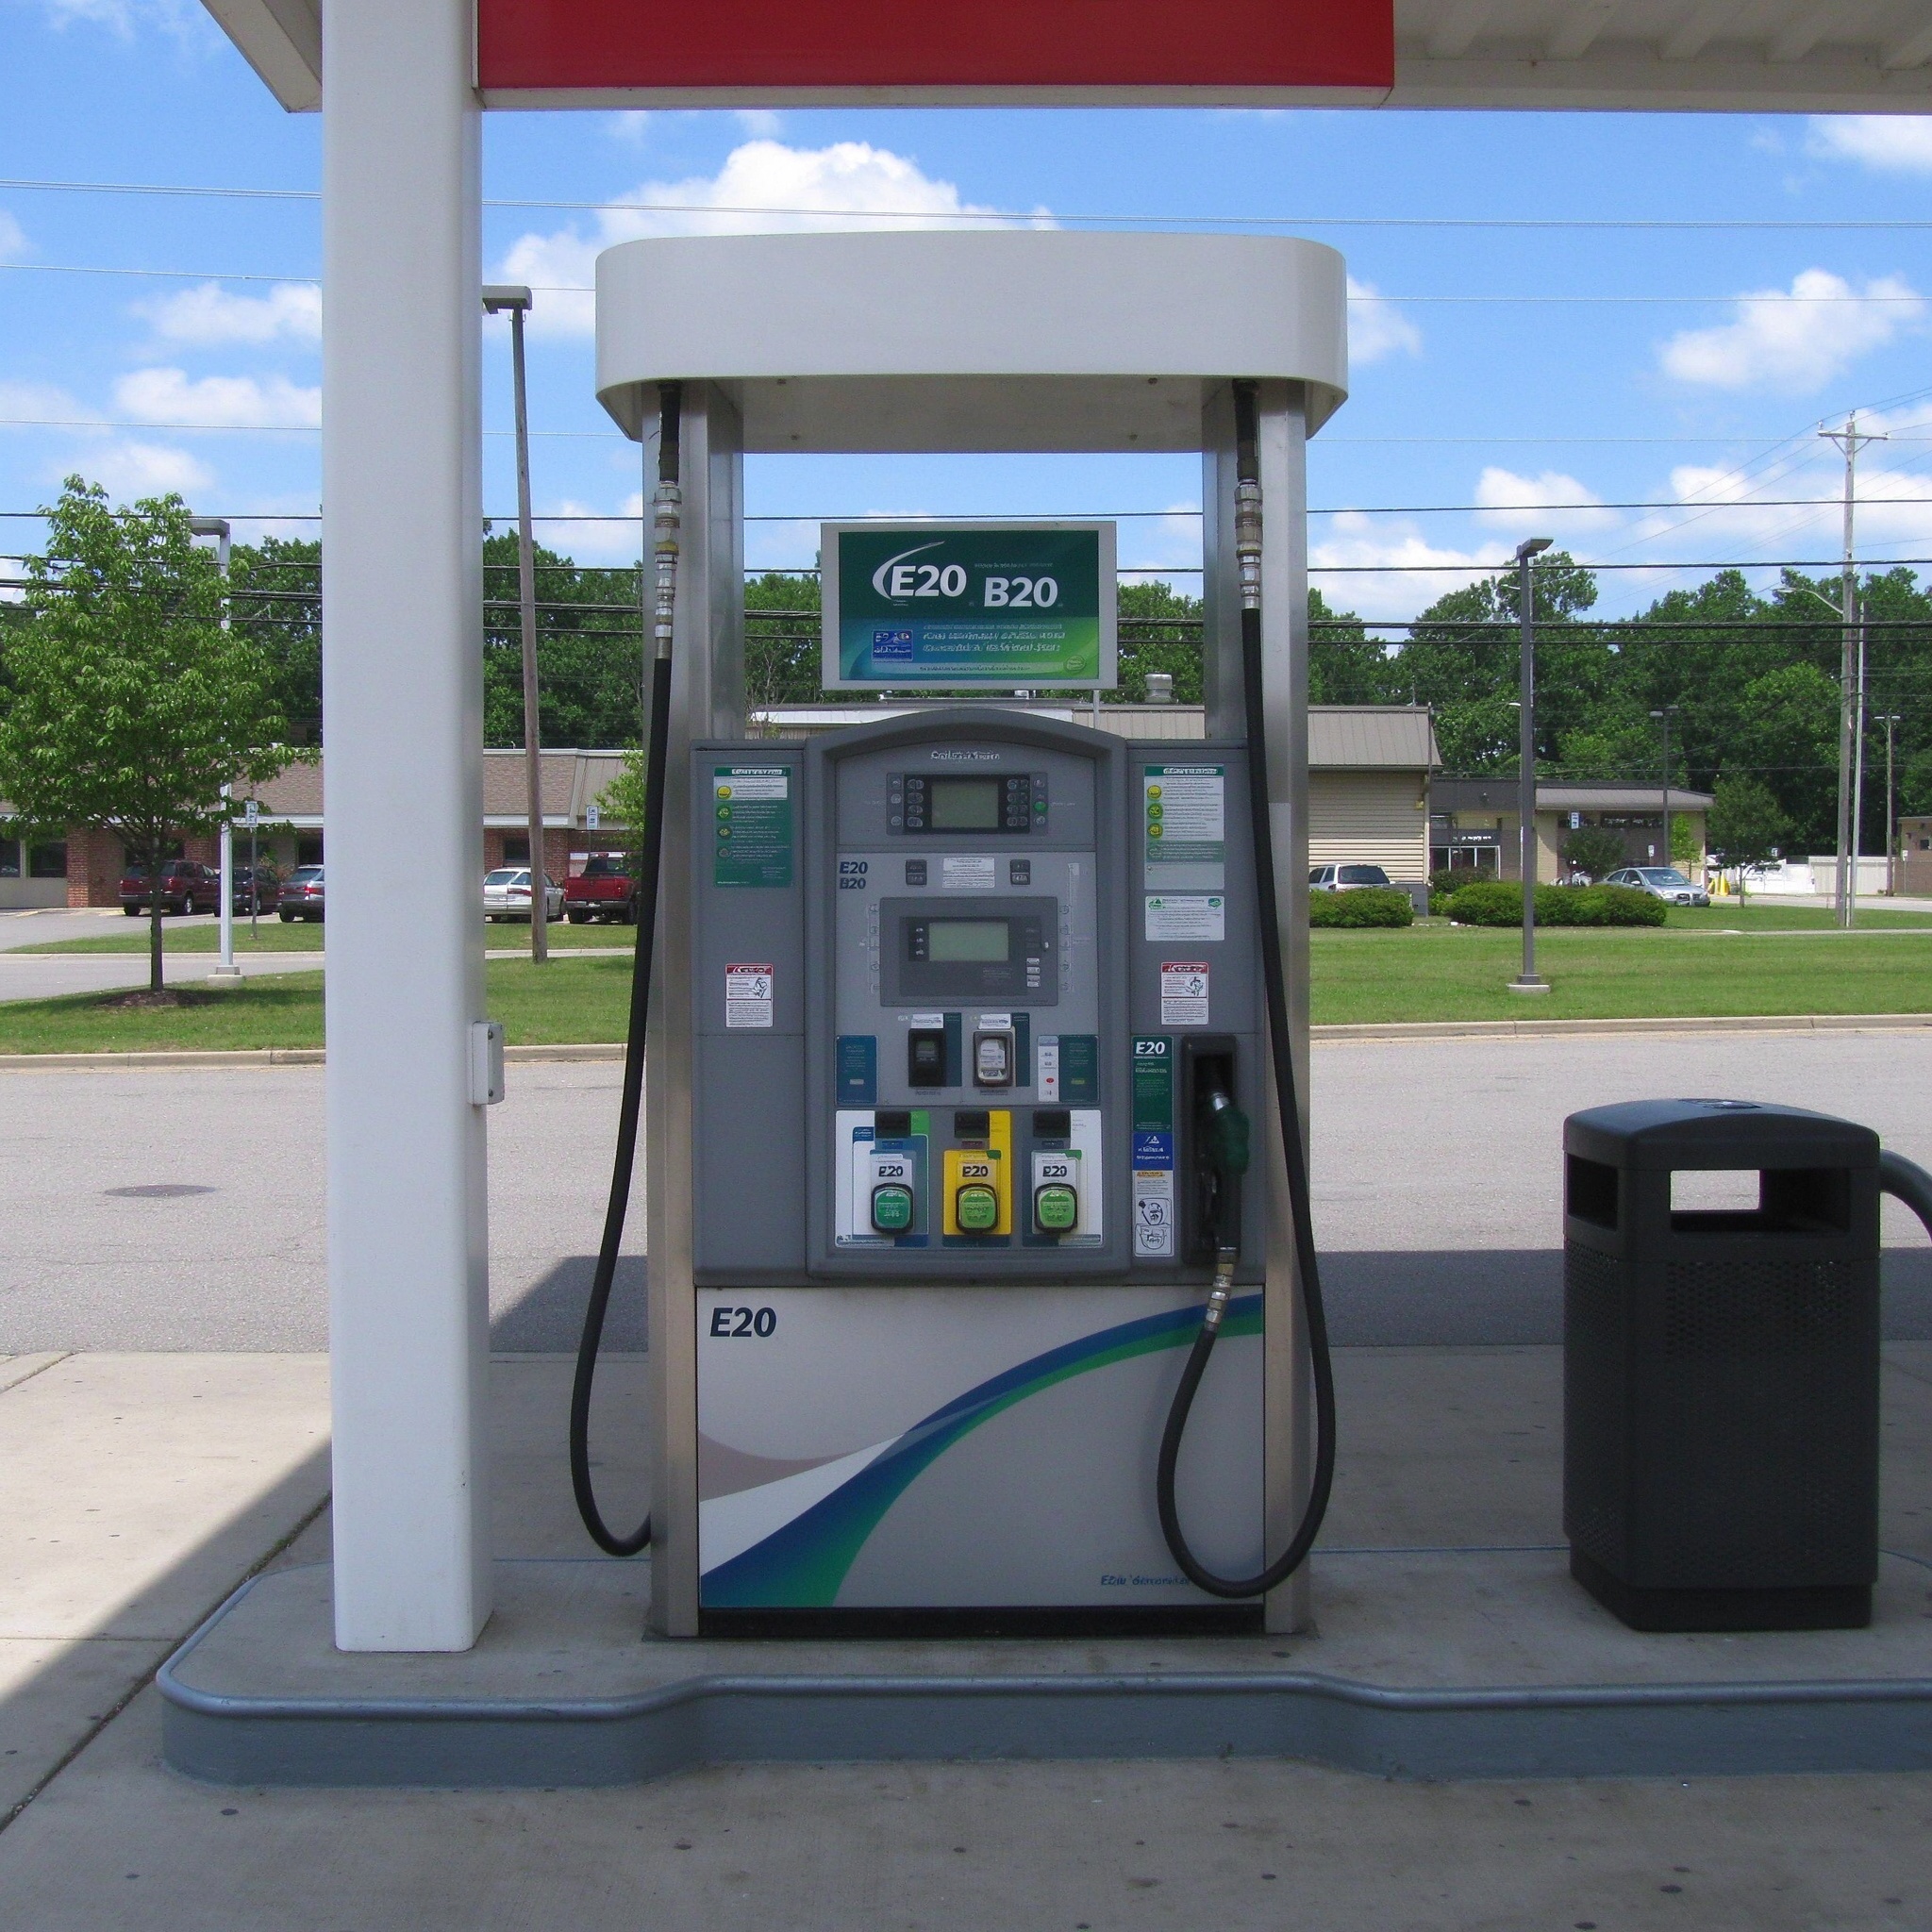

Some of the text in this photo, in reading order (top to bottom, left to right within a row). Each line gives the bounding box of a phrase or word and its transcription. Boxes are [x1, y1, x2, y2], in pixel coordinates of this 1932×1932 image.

[891, 565, 967, 597] E20
[984, 576, 1058, 608] B20
[840, 861, 868, 874] E20
[1136, 1041, 1166, 1055] E20
[709, 1307, 776, 1337] E20
